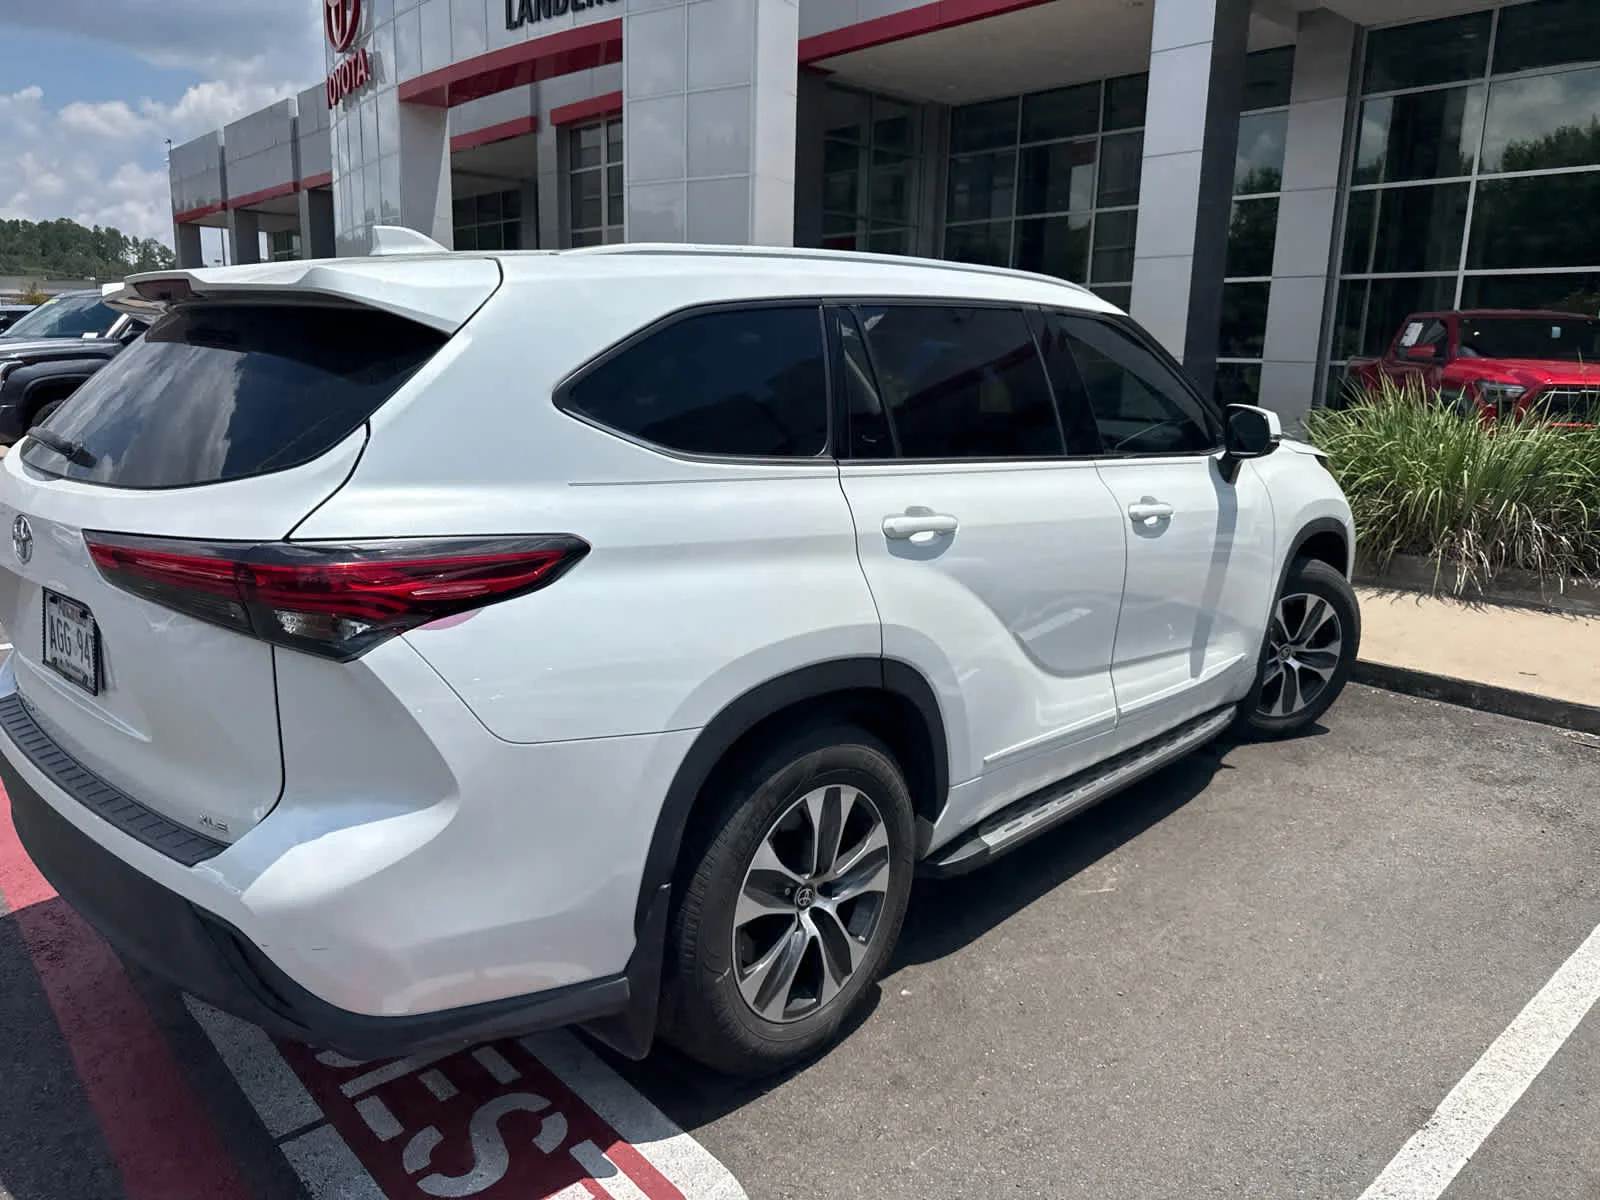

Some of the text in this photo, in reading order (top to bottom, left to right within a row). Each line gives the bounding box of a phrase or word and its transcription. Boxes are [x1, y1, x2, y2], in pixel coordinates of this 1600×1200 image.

[504, 0, 619, 30] LAND
[325, 47, 369, 110] TOYOTA
[49, 615, 72, 657] AGG
